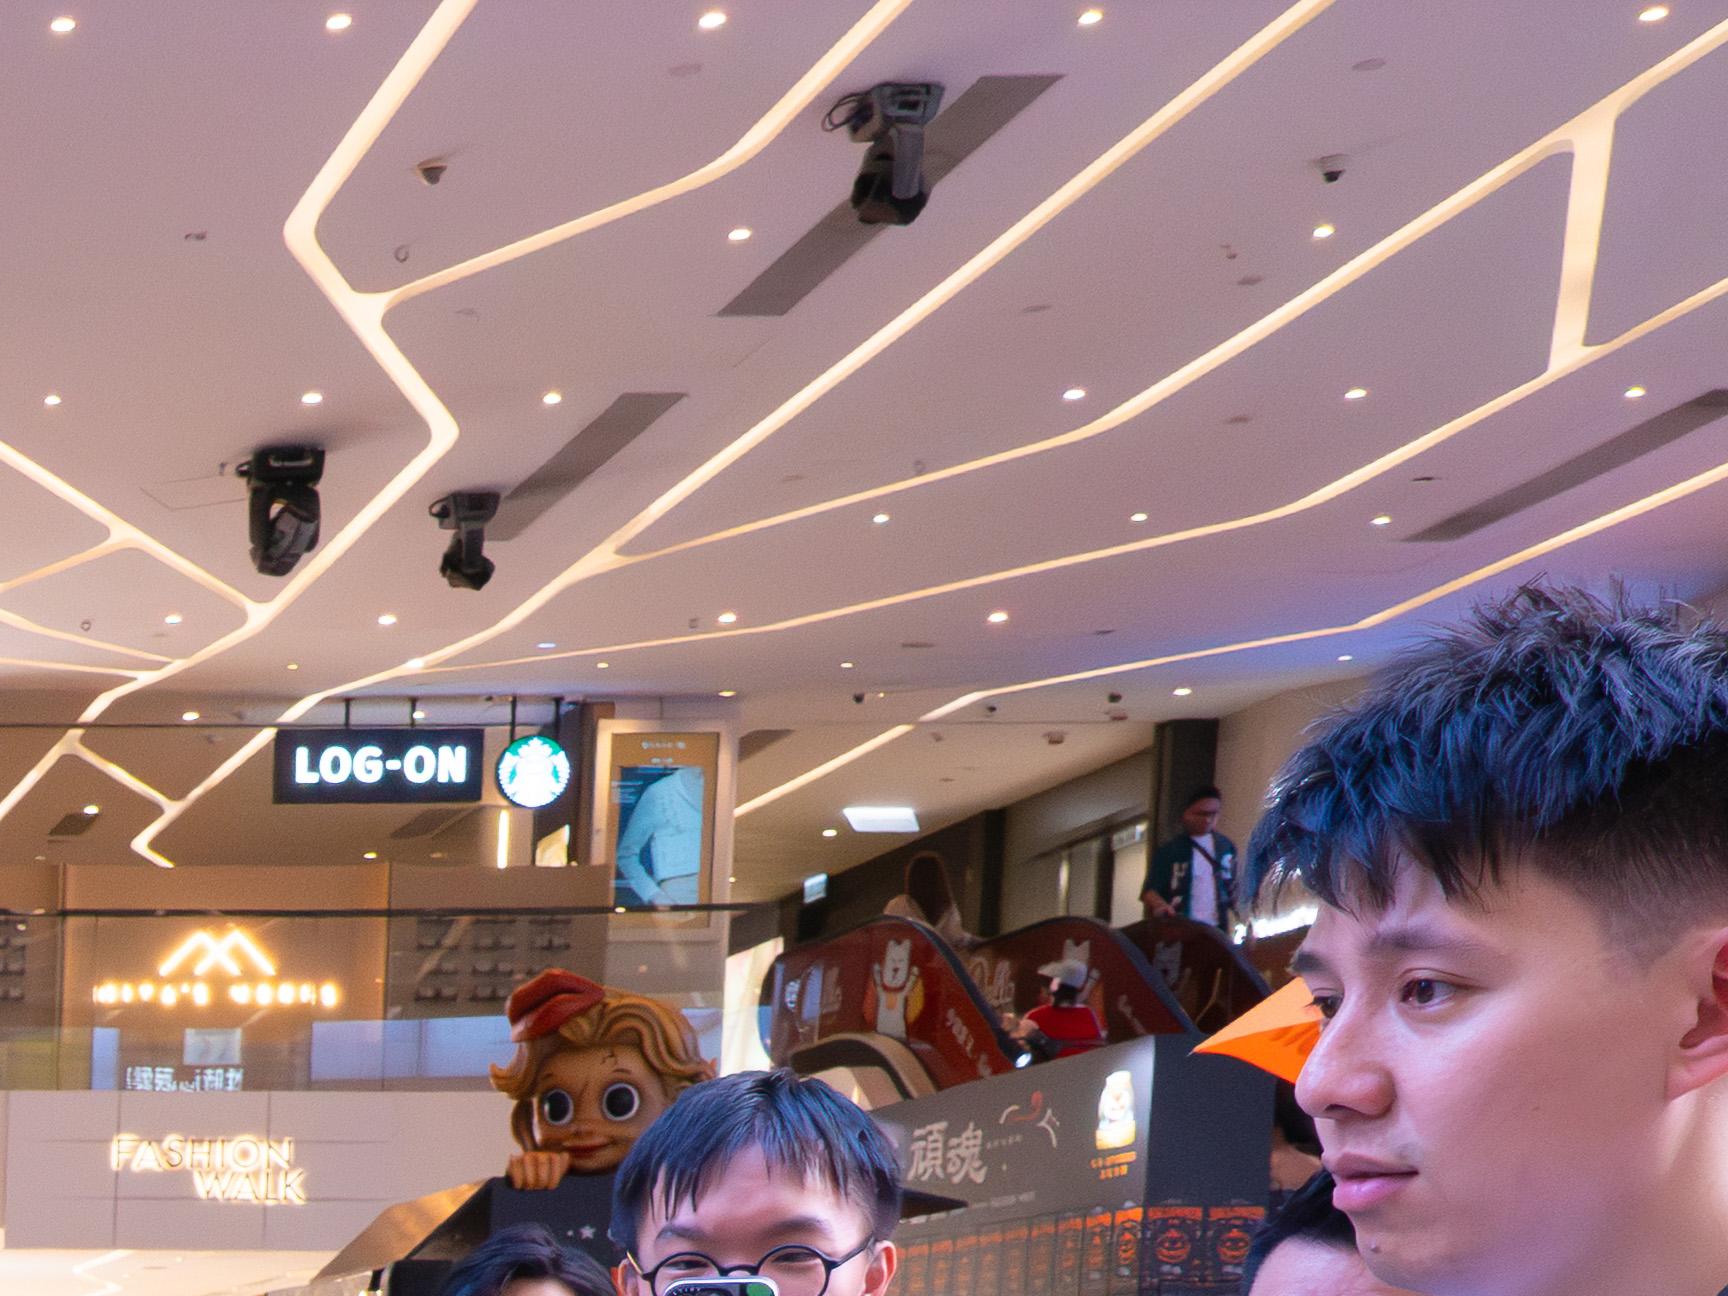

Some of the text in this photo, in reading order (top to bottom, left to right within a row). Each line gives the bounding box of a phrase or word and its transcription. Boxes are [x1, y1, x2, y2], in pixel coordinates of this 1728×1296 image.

[295, 745, 467, 784] LOG-ON
[111, 1134, 294, 1172] FASHION
[193, 1168, 307, 1206] WALK
